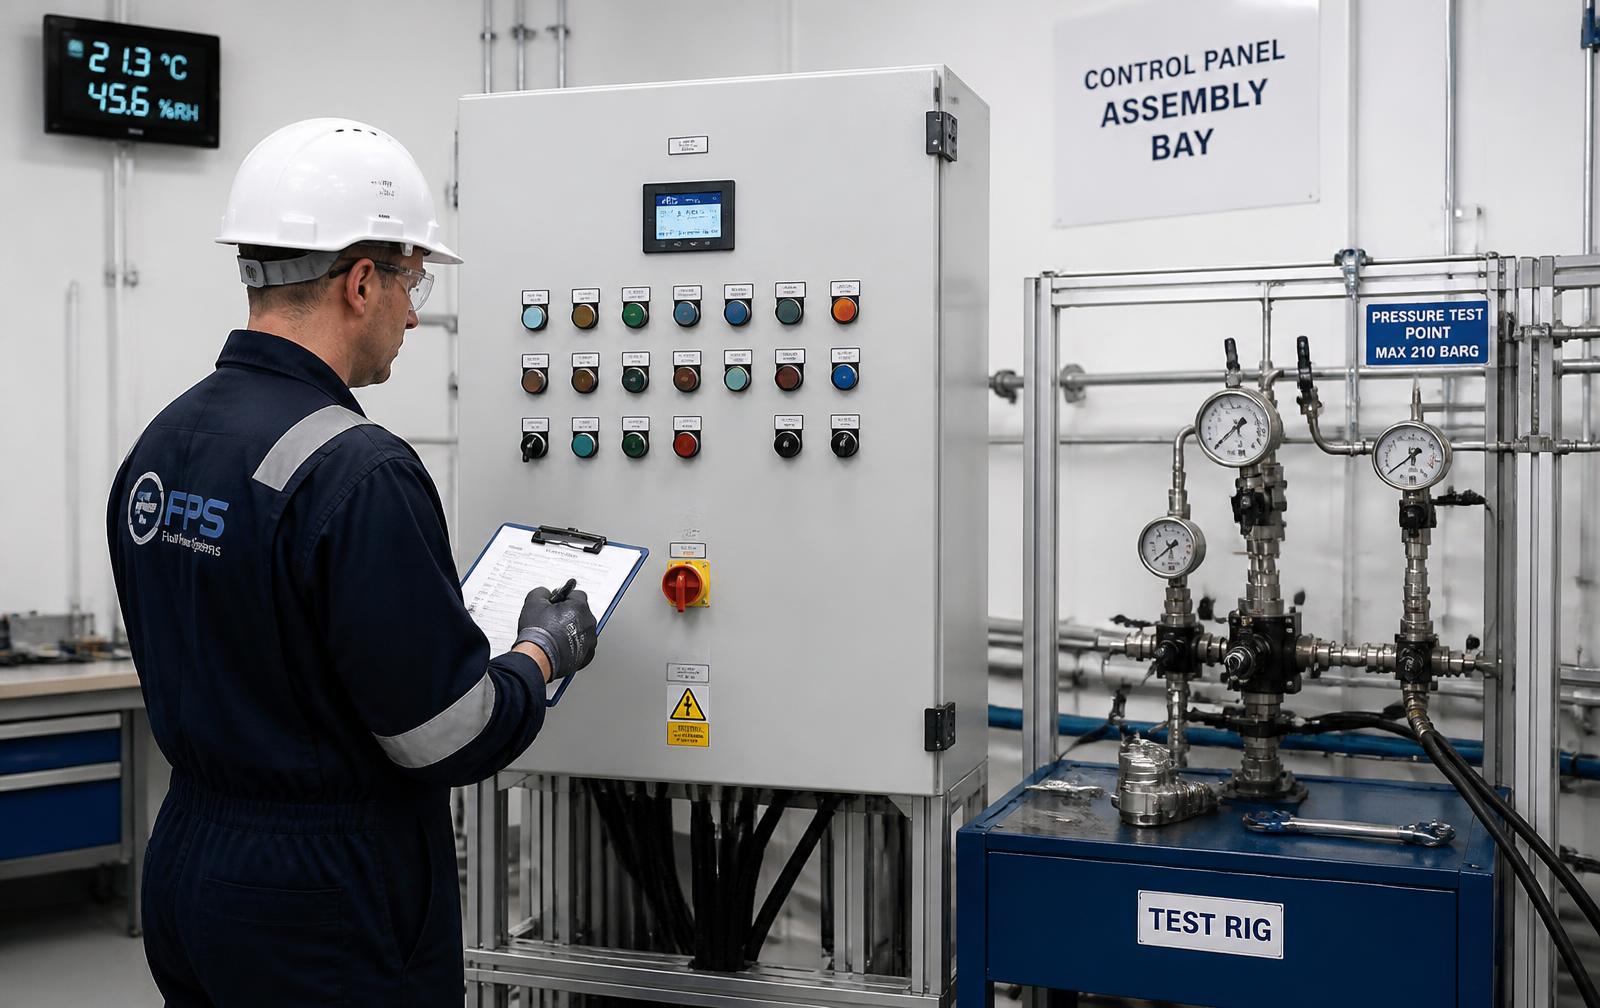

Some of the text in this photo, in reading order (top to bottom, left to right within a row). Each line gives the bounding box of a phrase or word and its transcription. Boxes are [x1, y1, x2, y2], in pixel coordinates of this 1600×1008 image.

[1084, 38, 1285, 91] CONTROL PANEL
[88, 82, 199, 122] 45.6 %RH
[1101, 77, 1268, 128] ASSEMBLY
[1152, 128, 1214, 161] BAY
[1372, 308, 1484, 324] PRESSURE TEST
[1405, 326, 1452, 340] POINT
[1375, 344, 1479, 359] MAX 210 BARG
[165, 491, 229, 538] FPS
[1148, 907, 1272, 942] TEST RIG
